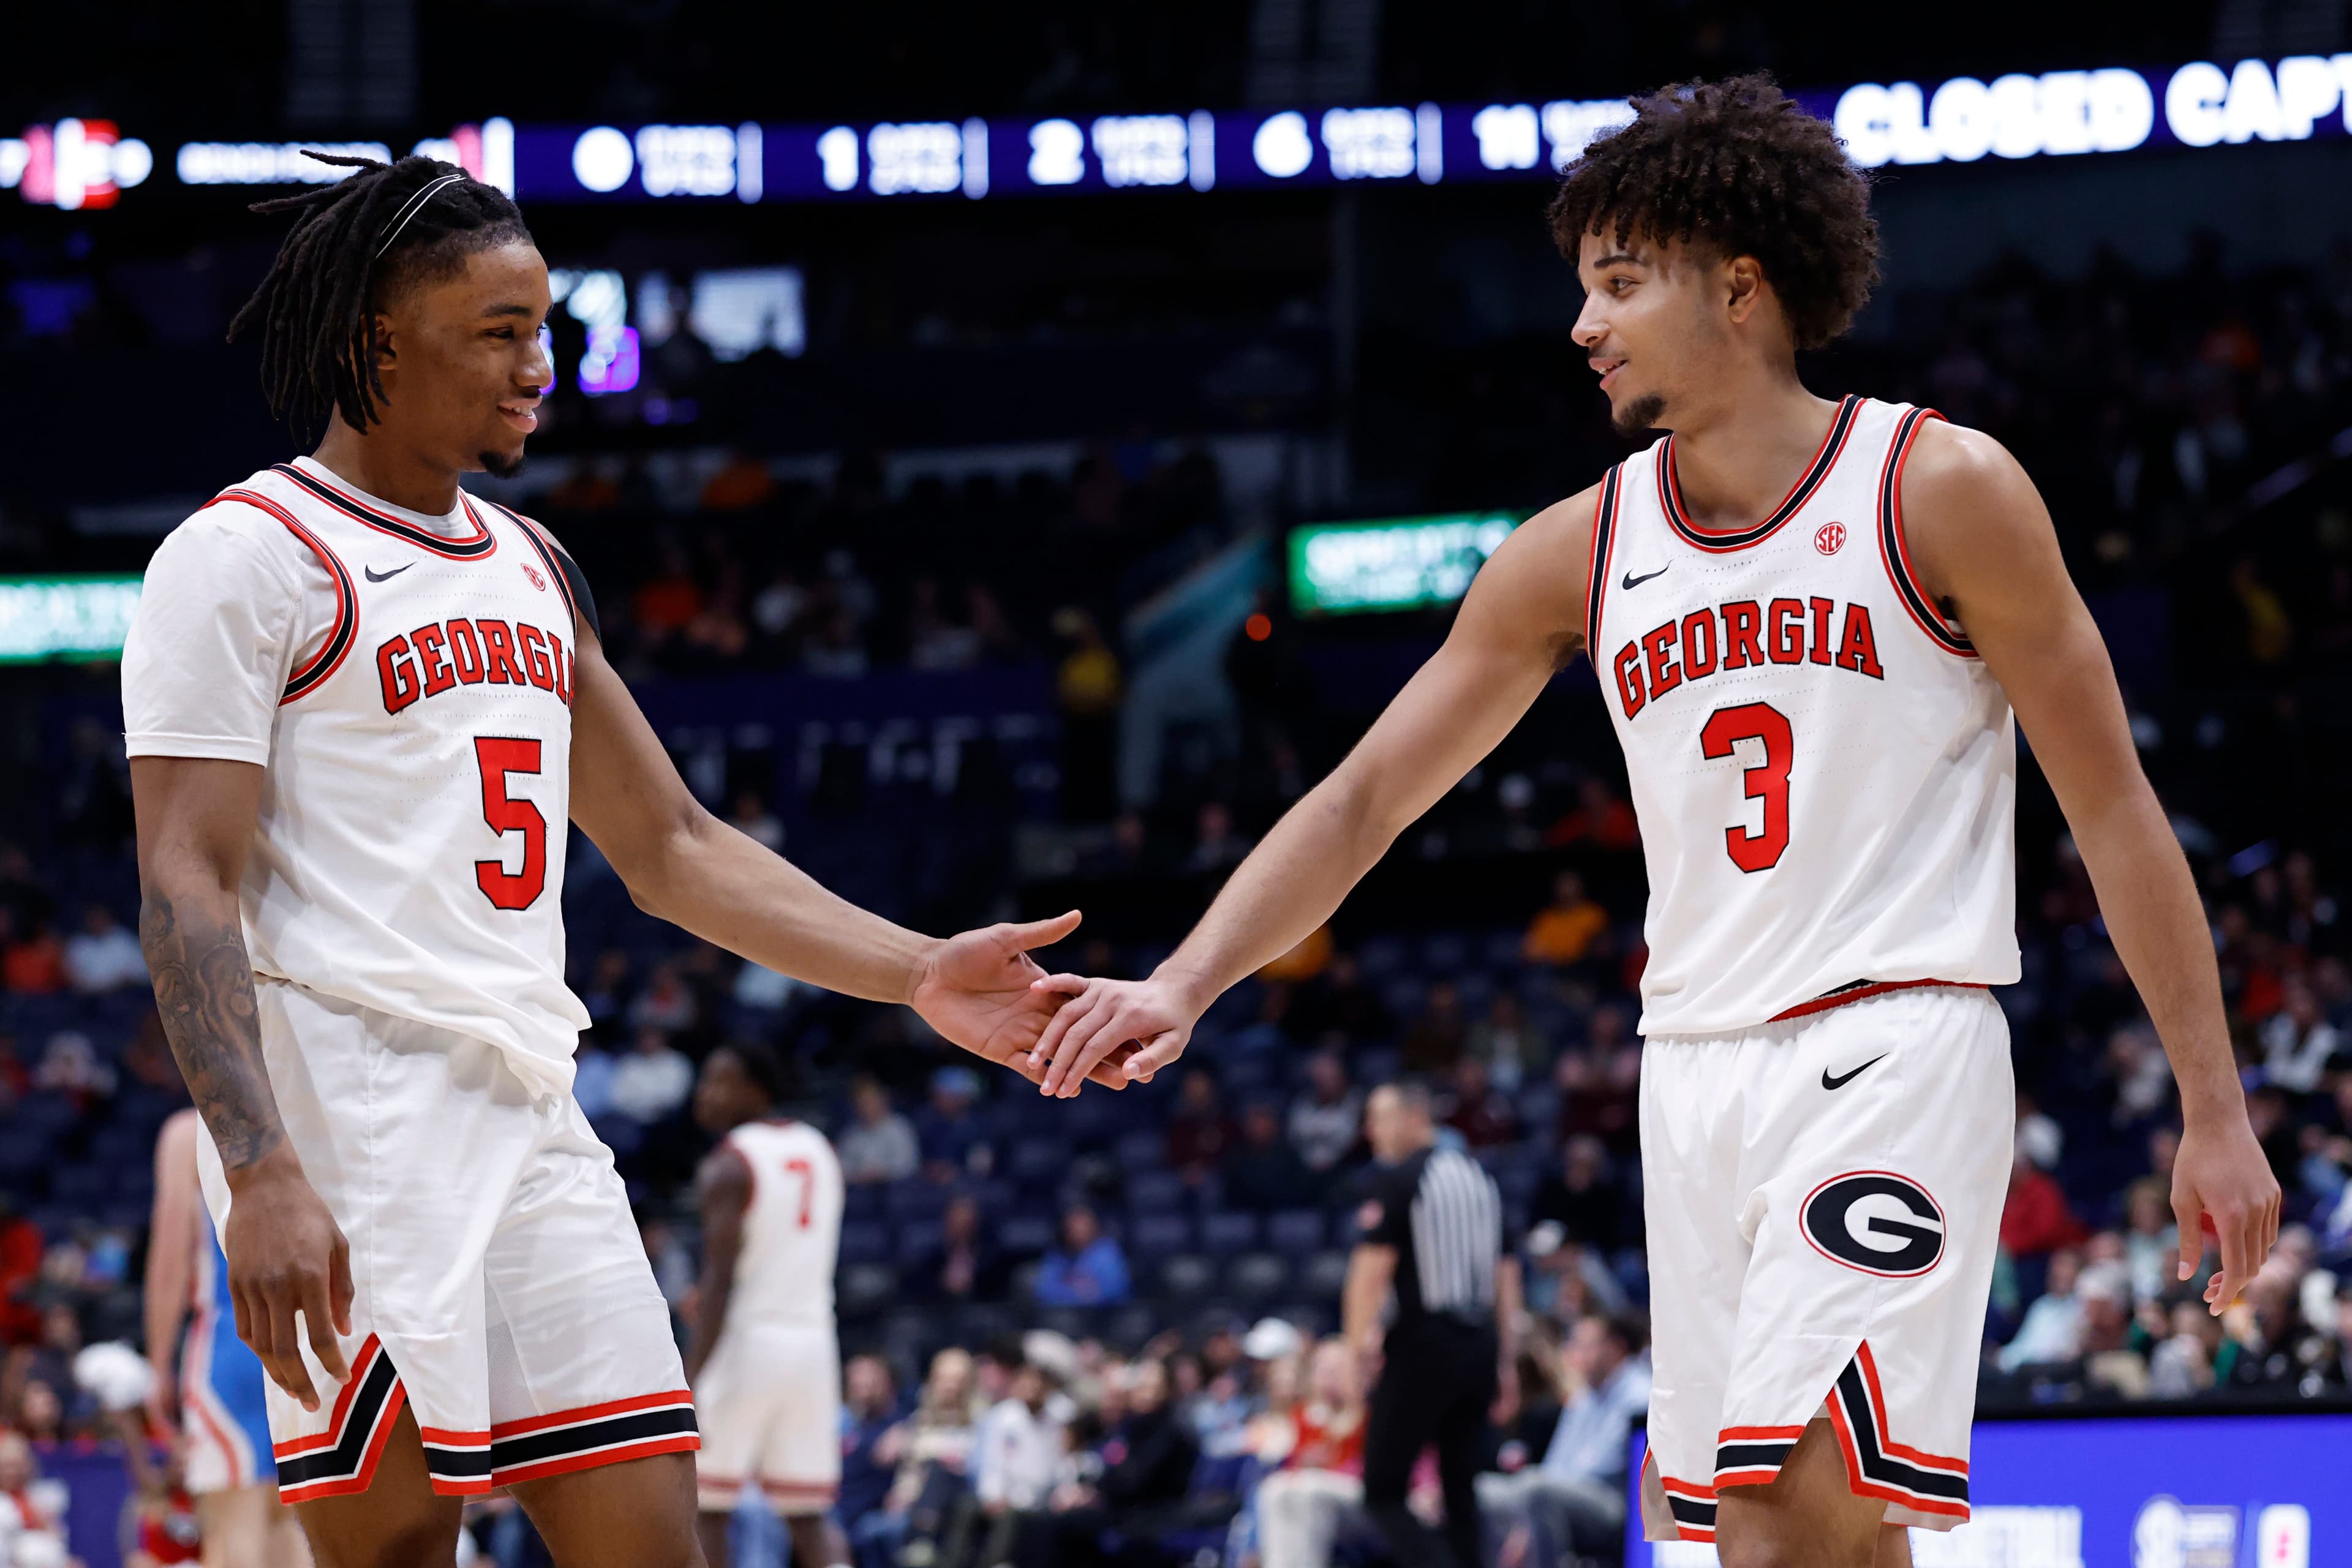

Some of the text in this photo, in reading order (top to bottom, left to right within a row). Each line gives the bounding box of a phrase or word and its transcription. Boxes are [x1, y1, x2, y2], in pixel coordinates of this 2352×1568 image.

[1835, 68, 2154, 167] CLOSED
[1817, 525, 1843, 552] SEC
[1614, 596, 1884, 721] GEORGIA
[473, 736, 546, 911] 5
[1700, 701, 1793, 873] 3
[784, 1157, 813, 1230] 7
[1806, 1177, 1942, 1271] G
